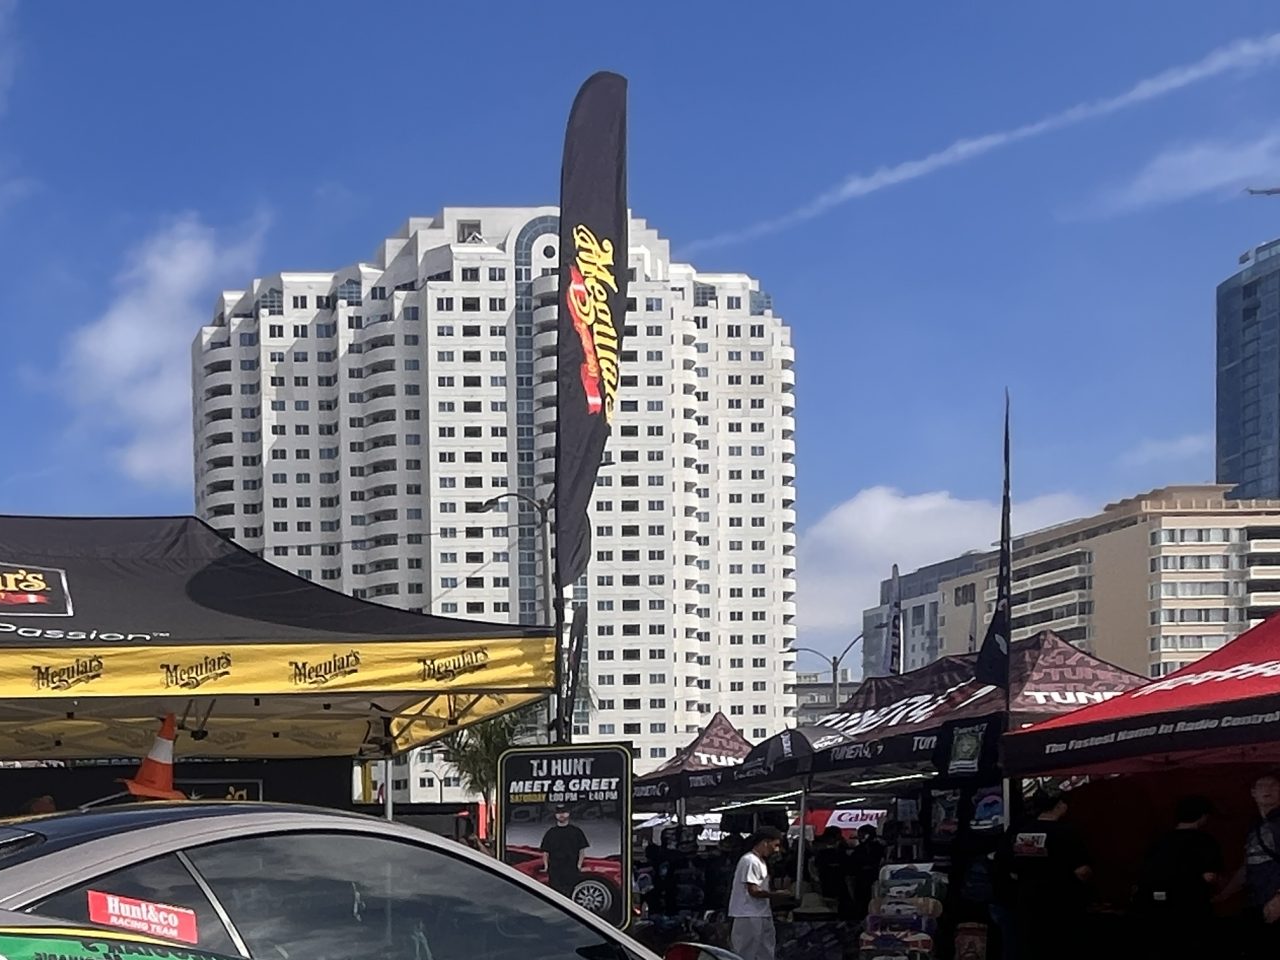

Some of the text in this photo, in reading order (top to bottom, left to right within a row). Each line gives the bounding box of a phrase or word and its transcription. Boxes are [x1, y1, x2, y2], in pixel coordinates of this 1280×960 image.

[31, 655, 104, 690] Meguiar's
[160, 652, 233, 690] Meguiar's
[288, 649, 361, 685] Meguiar's
[417, 645, 489, 682] Meguiar's
[1174, 718, 1219, 732] Radio
[530, 758, 596, 777] TJ HUNT
[509, 780, 551, 794] MEET
[553, 780, 566, 792] &
[569, 778, 620, 791] GREET
[110, 915, 179, 938] RACING TEAM
